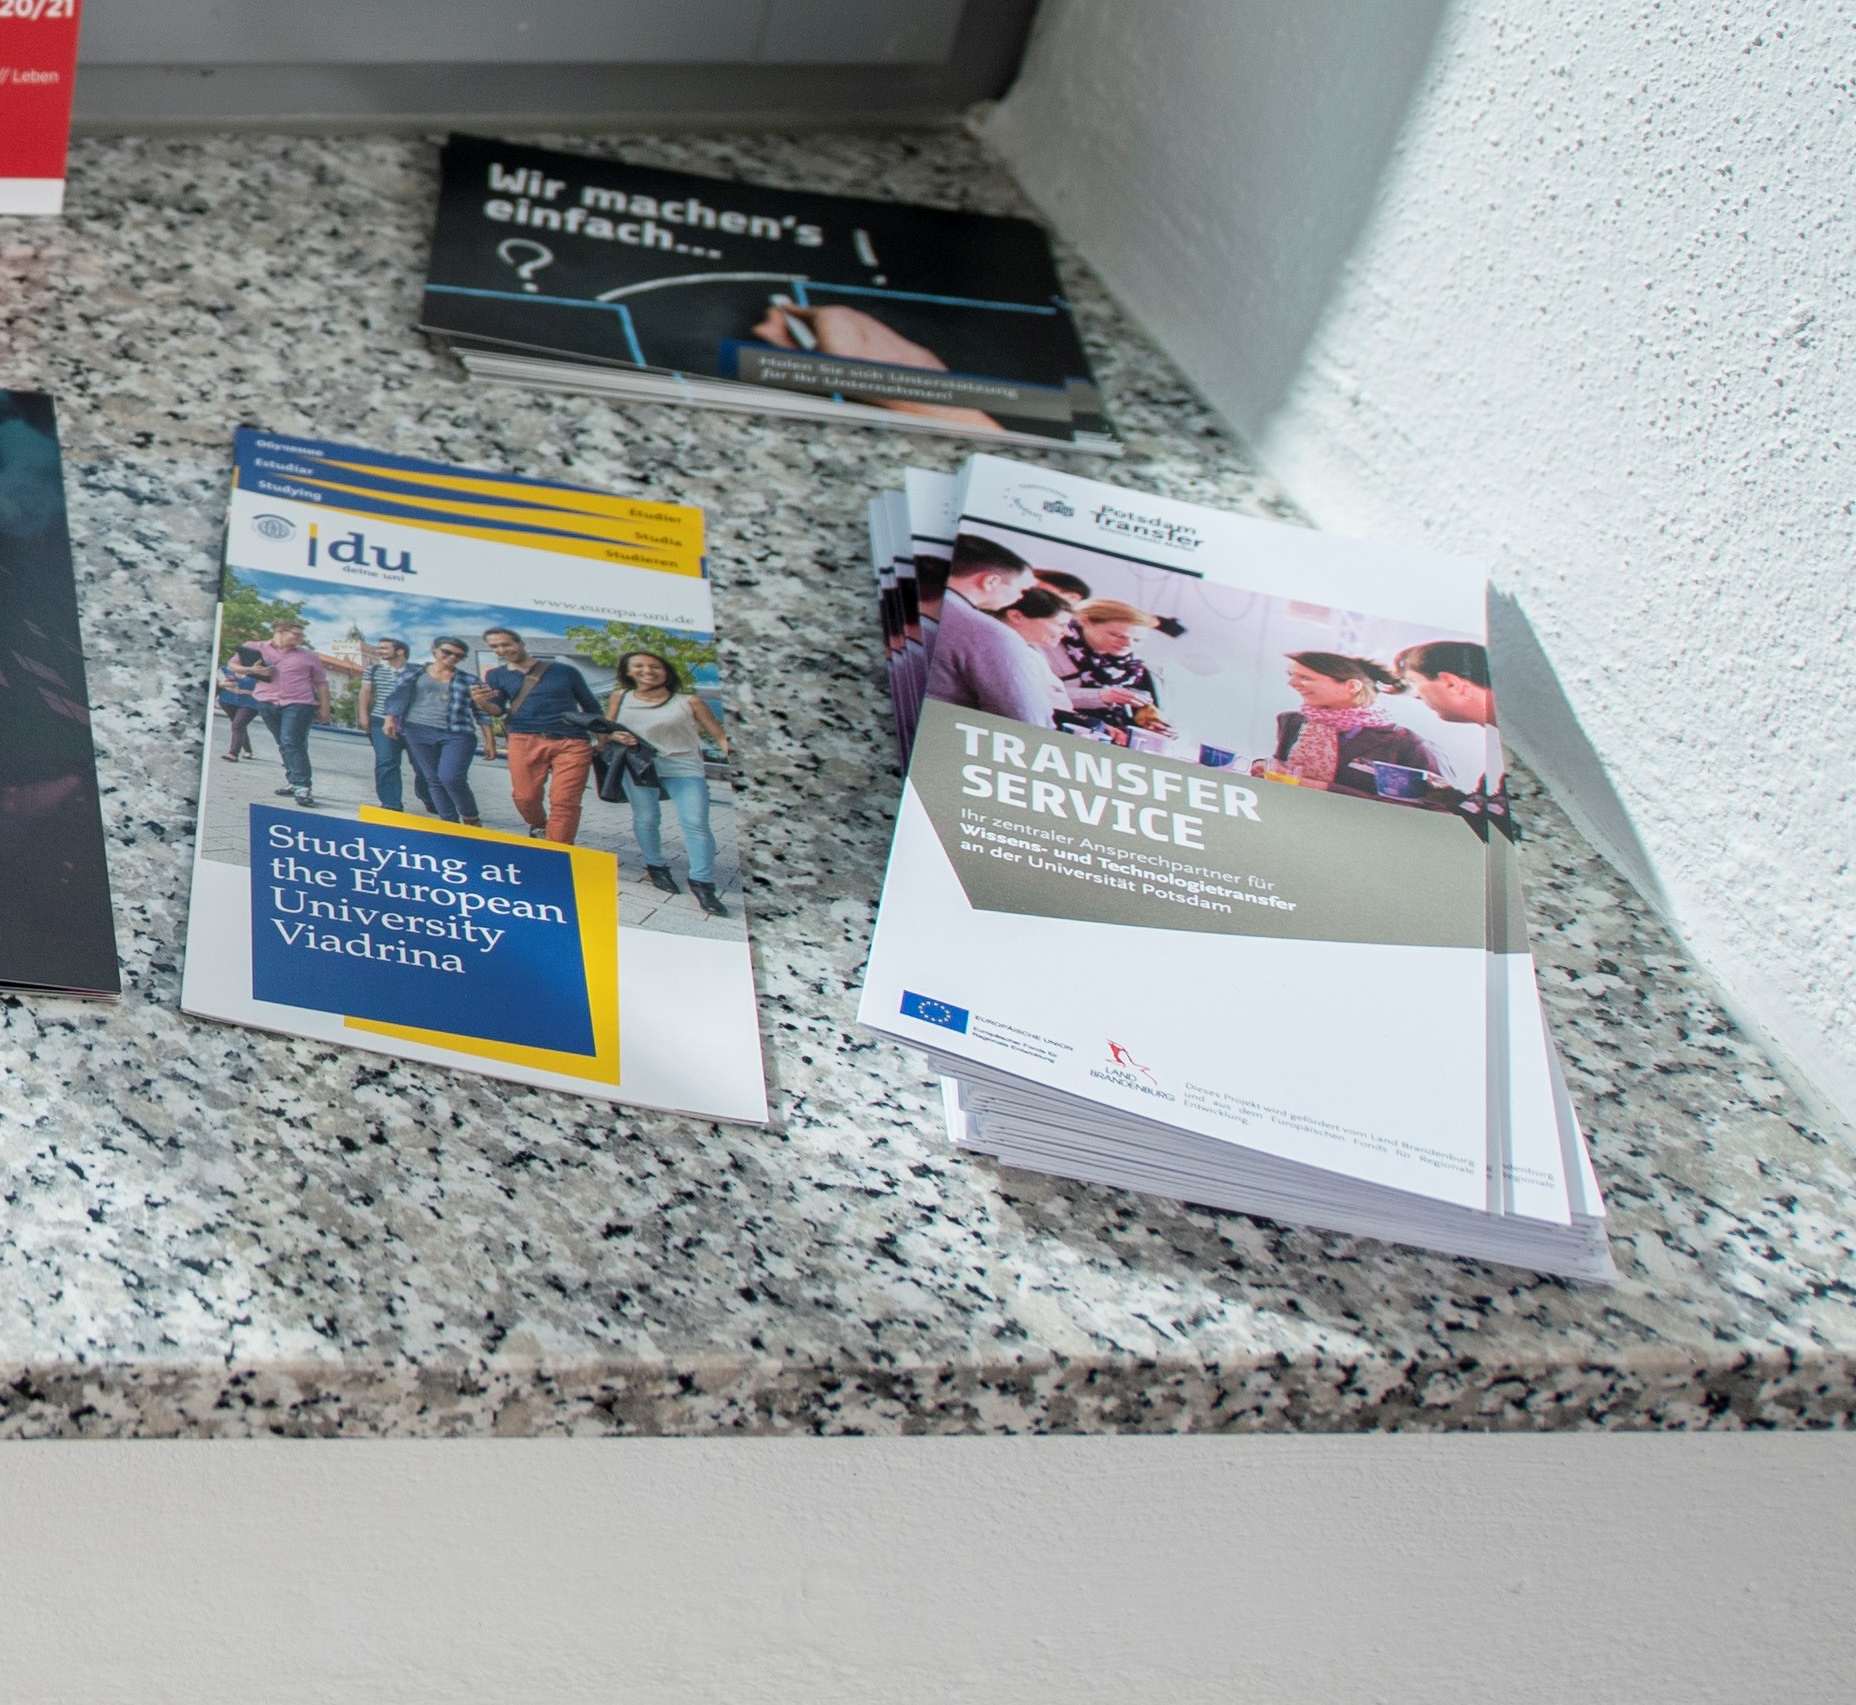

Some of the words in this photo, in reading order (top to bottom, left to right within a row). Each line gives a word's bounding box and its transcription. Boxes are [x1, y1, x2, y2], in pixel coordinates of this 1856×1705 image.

[13, 70, 59, 83] Leben
[489, 163, 567, 200] Wir
[483, 198, 723, 259] einfach...
[254, 458, 313, 475] Estudiar
[259, 480, 322, 501] Studying
[1090, 511, 1204, 547] Transfer
[1101, 505, 1197, 534] Potsdam
[328, 531, 417, 574] du
[635, 531, 682, 547] Studia
[343, 565, 379, 577] deine
[382, 573, 405, 582] uni
[606, 549, 678, 568] Studieren
[533, 599, 694, 624] www.europa-uni.de
[955, 723, 1261, 822] TRANSFER
[962, 764, 1205, 850] SERVICE
[269, 825, 468, 884] Studying
[481, 864, 521, 885] at
[959, 822, 1048, 855] Wissens-
[1053, 850, 1092, 865] und
[1097, 857, 1297, 911] Technologietransfer
[961, 808, 986, 823] Ihr
[992, 817, 1074, 845] zentraler
[1079, 838, 1241, 885] Ansprechpartner
[1247, 875, 1274, 891] für
[271, 858, 337, 888] the
[350, 868, 566, 924] European
[960, 840, 984, 853] an
[990, 845, 1023, 863] der
[1028, 856, 1137, 892] Universität
[1142, 883, 1233, 914] Potsdam
[271, 886, 505, 953] University
[271, 918, 465, 973] Viadrina
[974, 1015, 1041, 1041] EUROPÄISCHE
[1043, 1038, 1074, 1051] UNION
[1090, 1069, 1176, 1102] BRANDENBURG
[1105, 1067, 1137, 1081] LAND
[1185, 1082, 1220, 1098] Dieses
